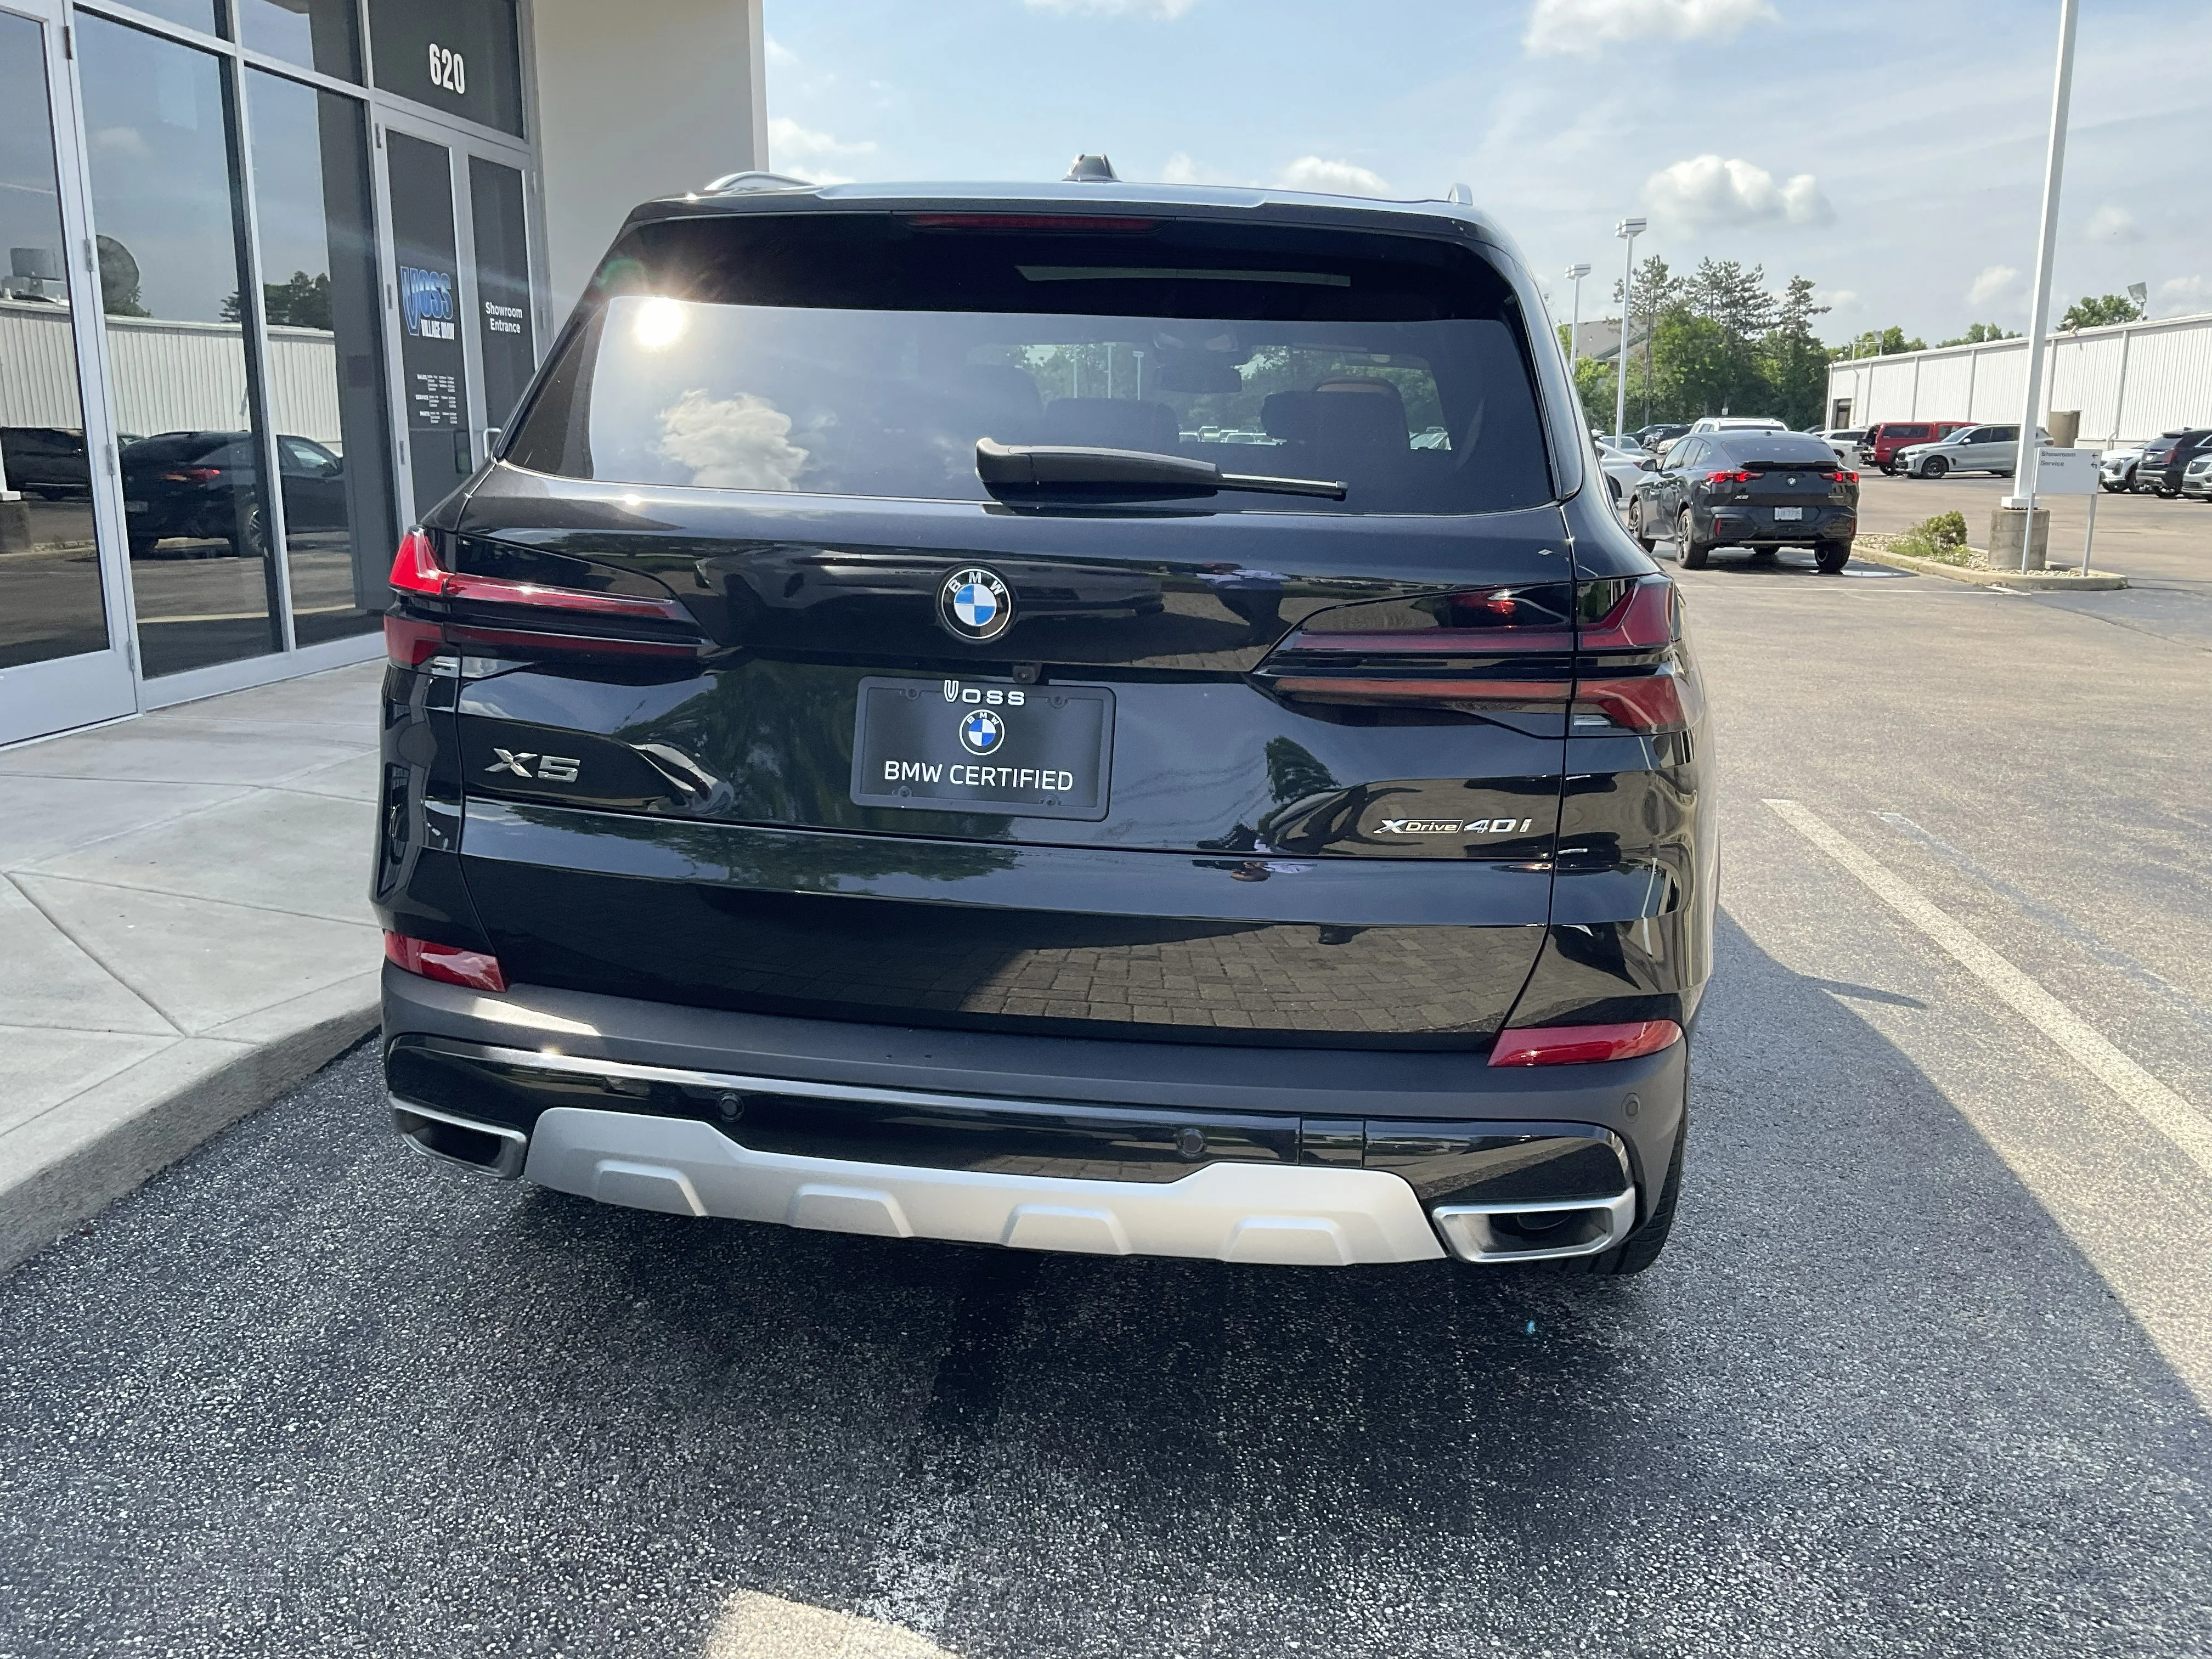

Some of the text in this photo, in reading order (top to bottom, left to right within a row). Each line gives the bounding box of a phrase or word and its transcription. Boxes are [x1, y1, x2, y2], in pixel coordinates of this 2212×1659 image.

[429, 43, 465, 94] 620
[400, 266, 453, 336] VOSS
[486, 302, 523, 318] Showroom
[421, 319, 441, 338] VILLAGE
[490, 318, 521, 333] Entrance
[484, 748, 581, 783] X5
[884, 761, 1074, 791] BMW CERTIFIED
